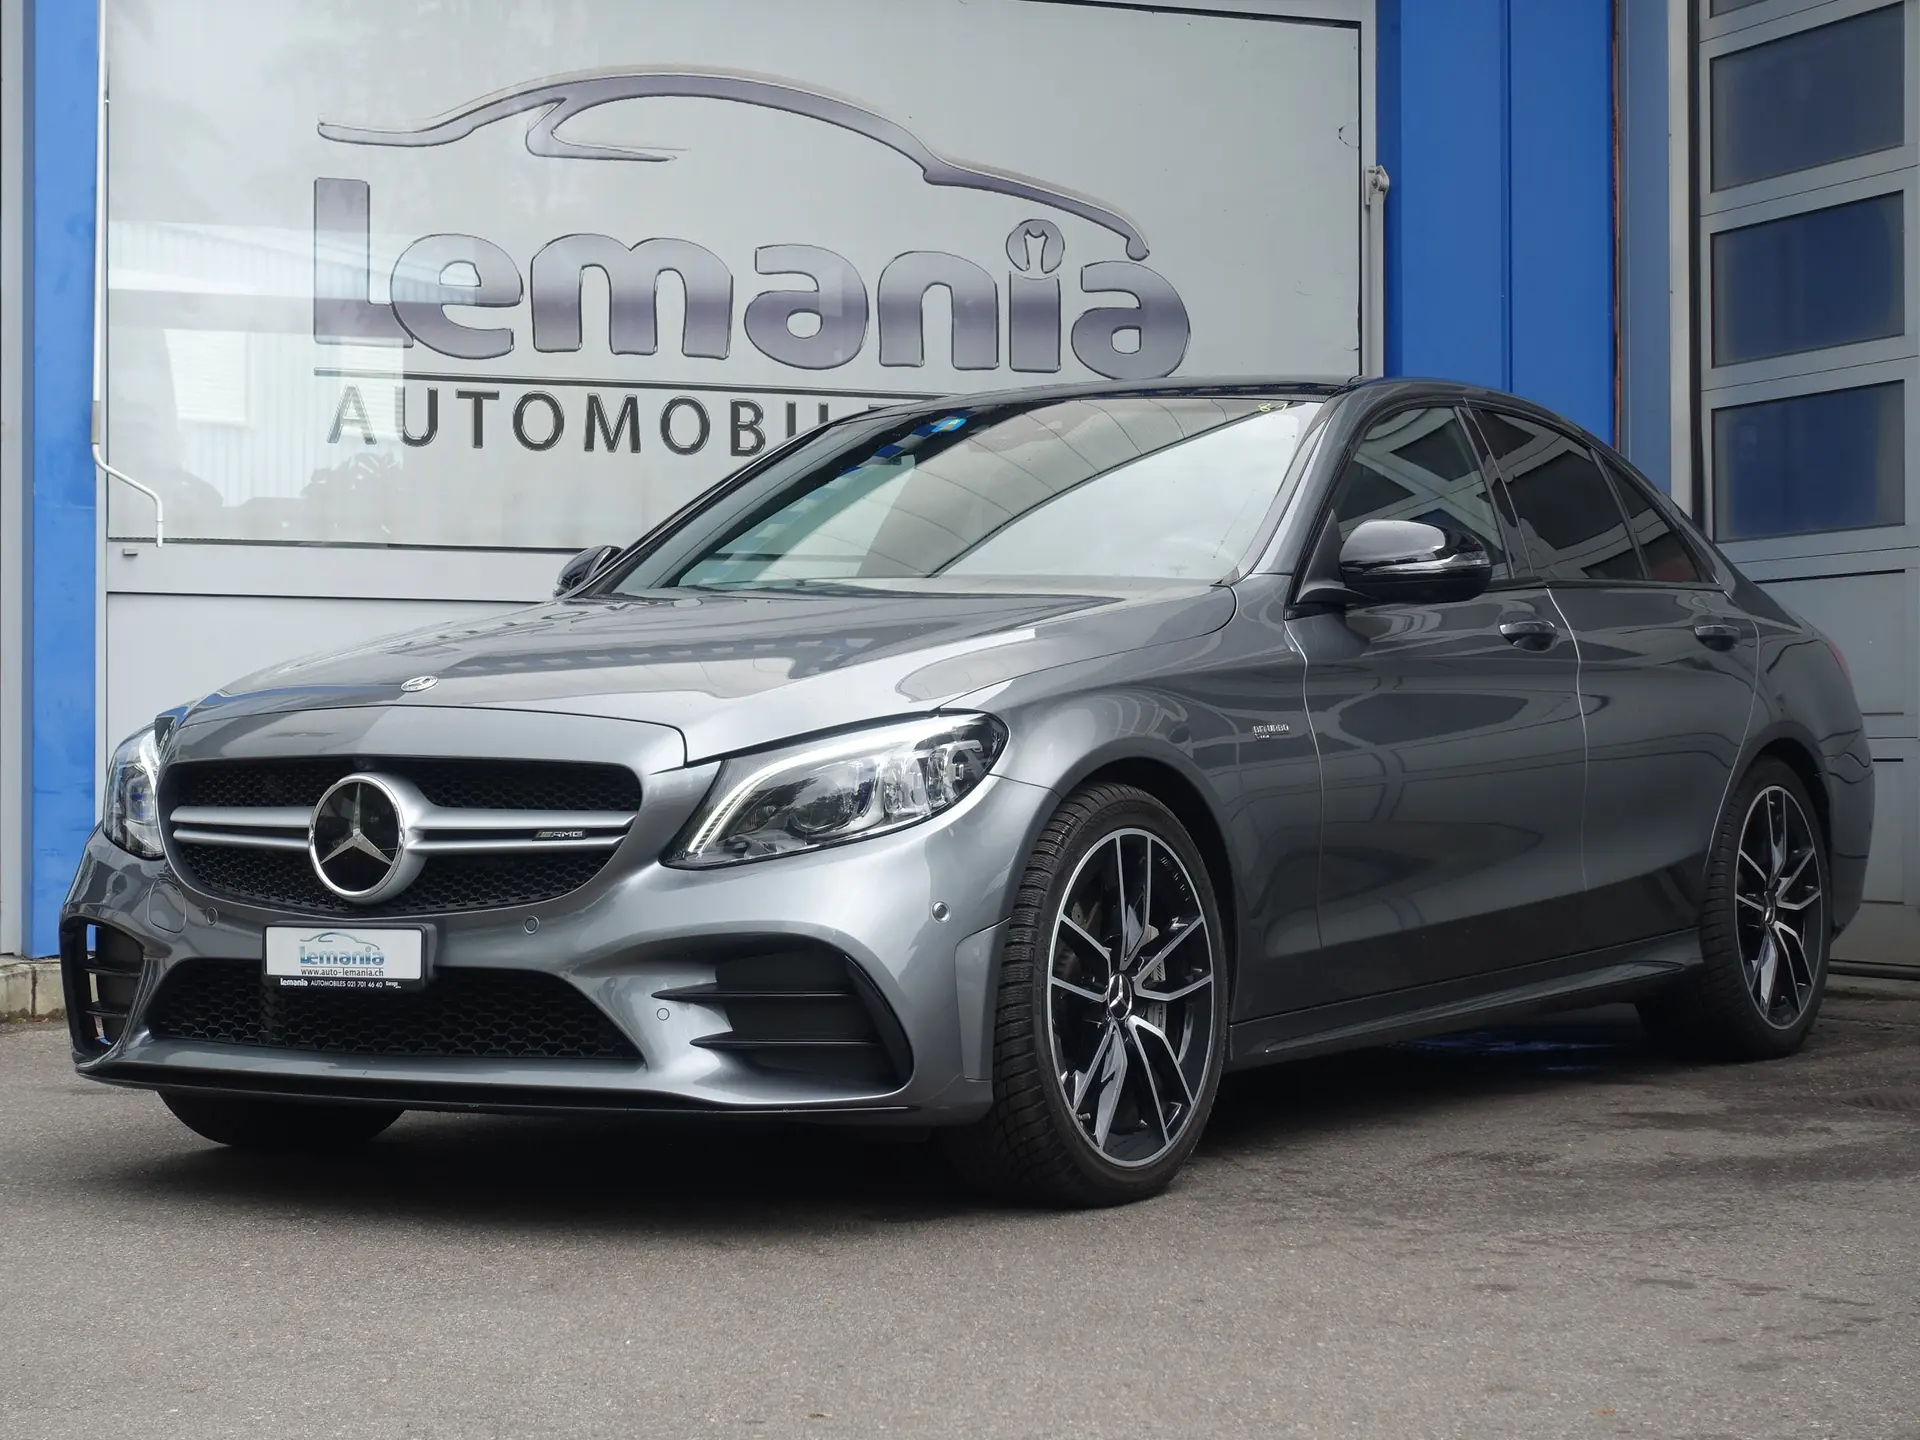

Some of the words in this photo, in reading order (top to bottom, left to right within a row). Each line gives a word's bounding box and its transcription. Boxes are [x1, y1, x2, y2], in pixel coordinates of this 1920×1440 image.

[313, 176, 1192, 380] Lemania
[326, 384, 893, 458] AUTOMOBI
[299, 945, 385, 966] Lemania
[300, 967, 384, 977] www.auto-lemania.ch
[347, 980, 356, 988] 021
[357, 980, 367, 988] 701
[367, 980, 375, 989] 46
[375, 981, 383, 989] 40
